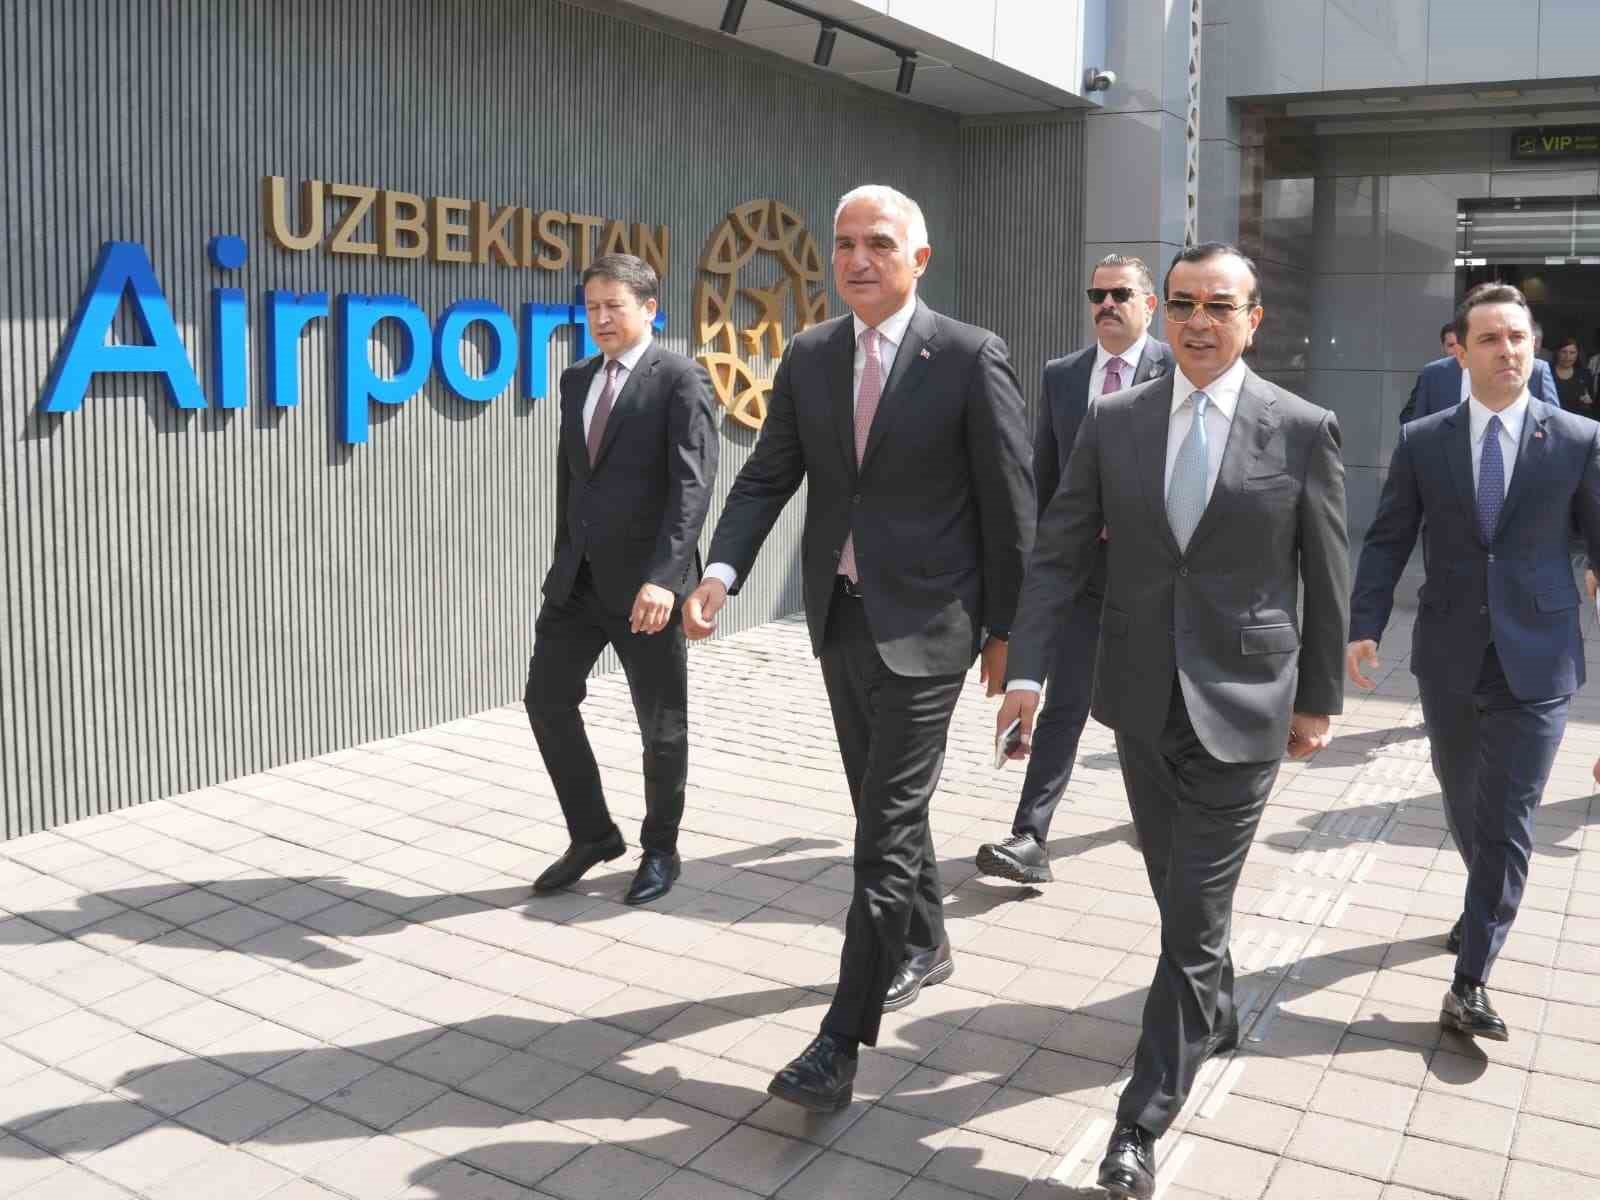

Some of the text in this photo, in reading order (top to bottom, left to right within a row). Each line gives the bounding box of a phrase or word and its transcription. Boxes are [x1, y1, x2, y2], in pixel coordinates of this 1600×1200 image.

[1541, 135, 1572, 152] VIP
[263, 175, 671, 280] UZBEKISTAN
[38, 234, 667, 445] Airpor
